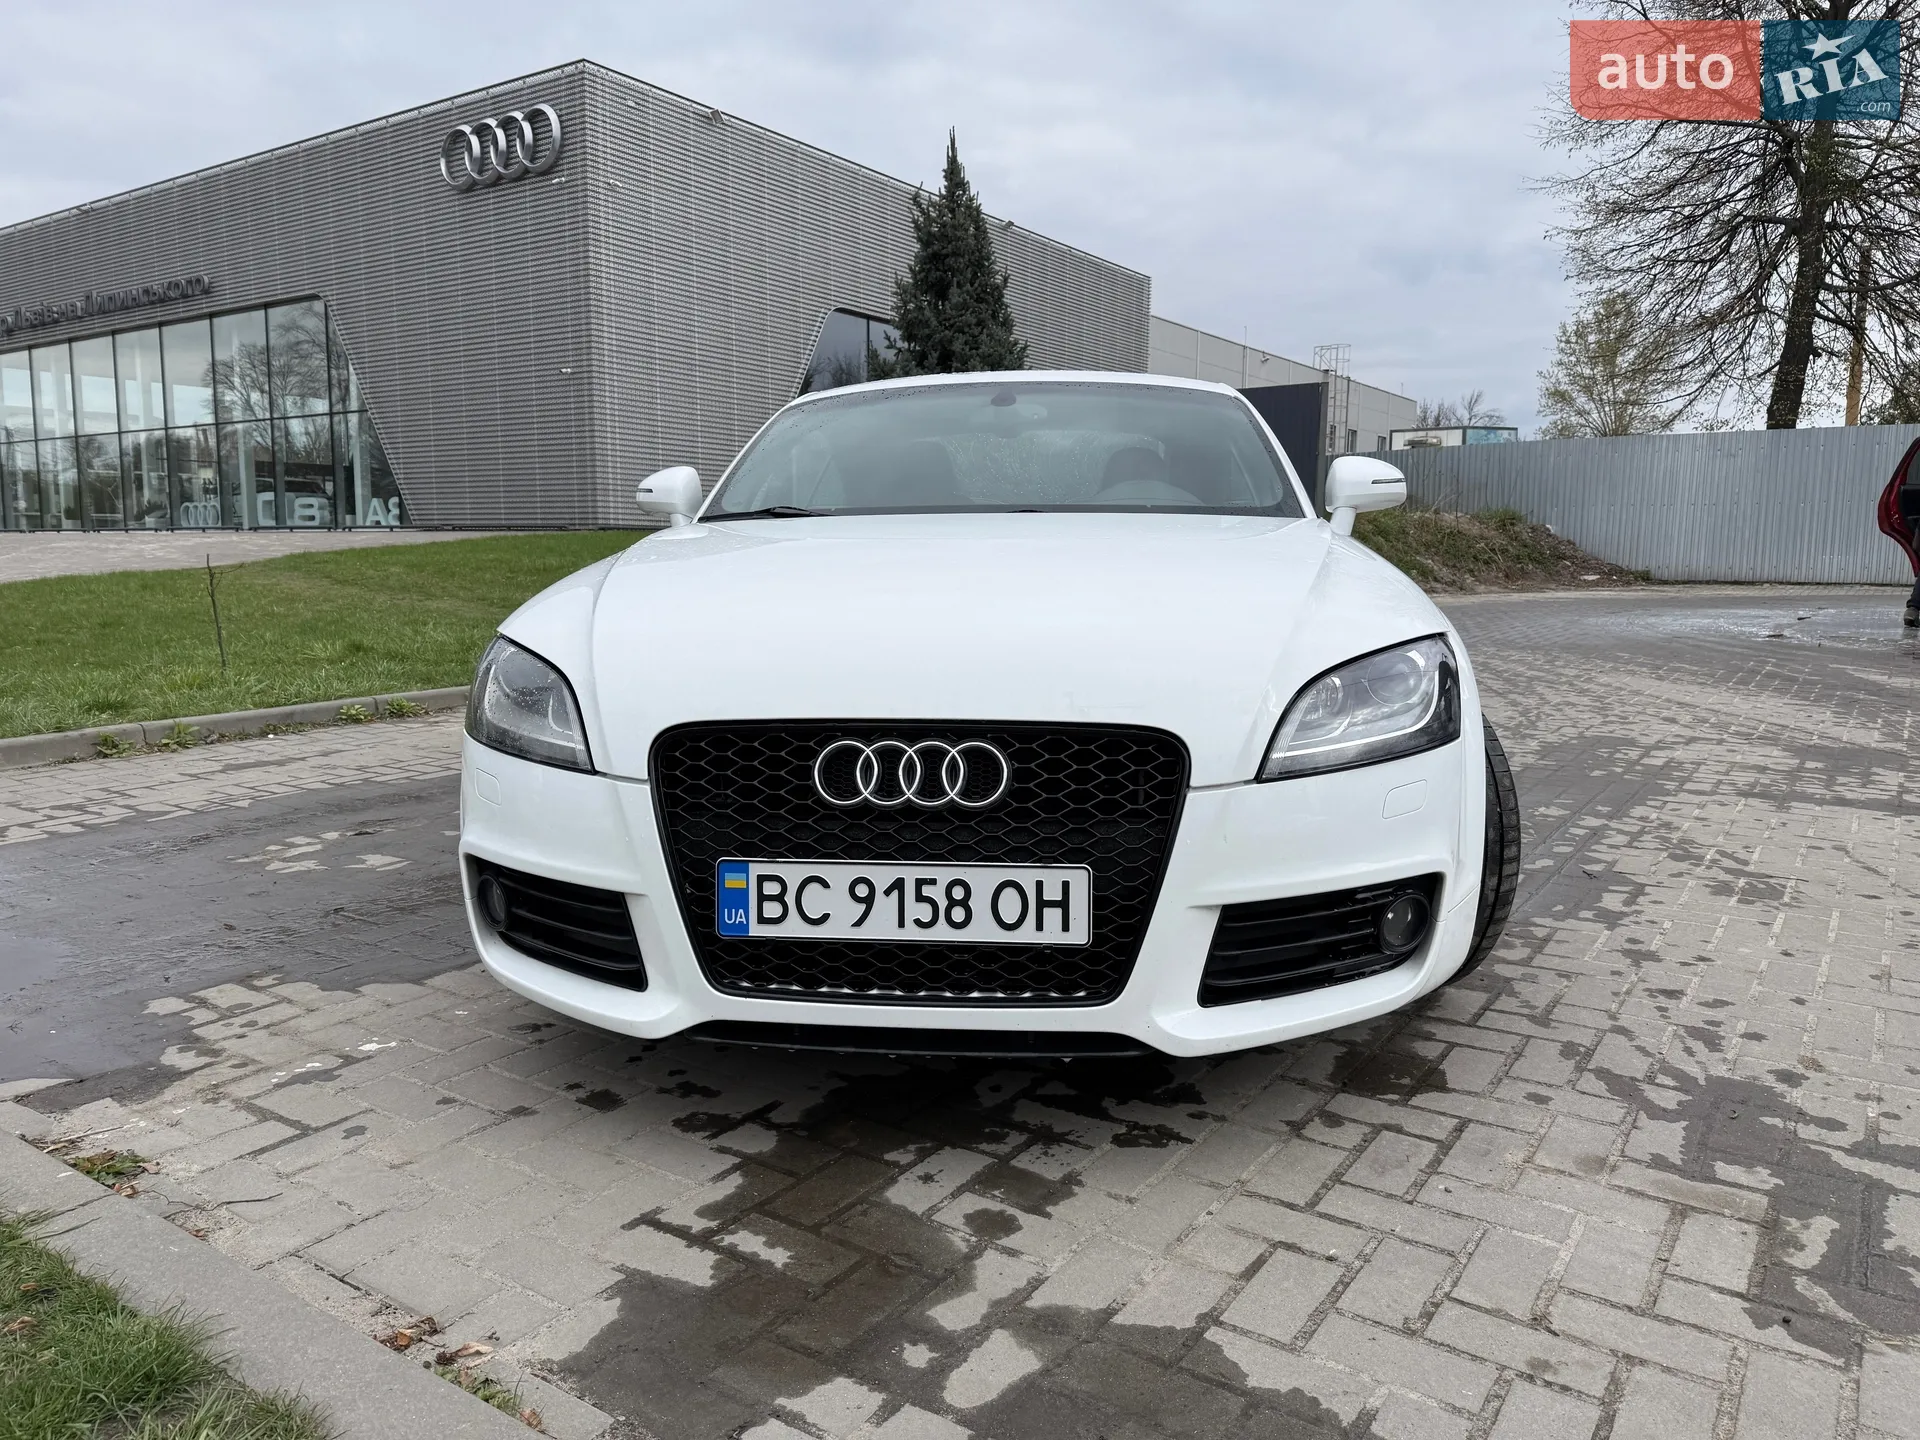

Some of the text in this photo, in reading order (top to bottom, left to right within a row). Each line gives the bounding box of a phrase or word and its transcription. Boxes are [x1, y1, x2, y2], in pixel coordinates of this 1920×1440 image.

[83, 275, 209, 317] Липинського
[724, 908, 747, 925] UA
[756, 873, 1071, 933] BC 9158 OH
